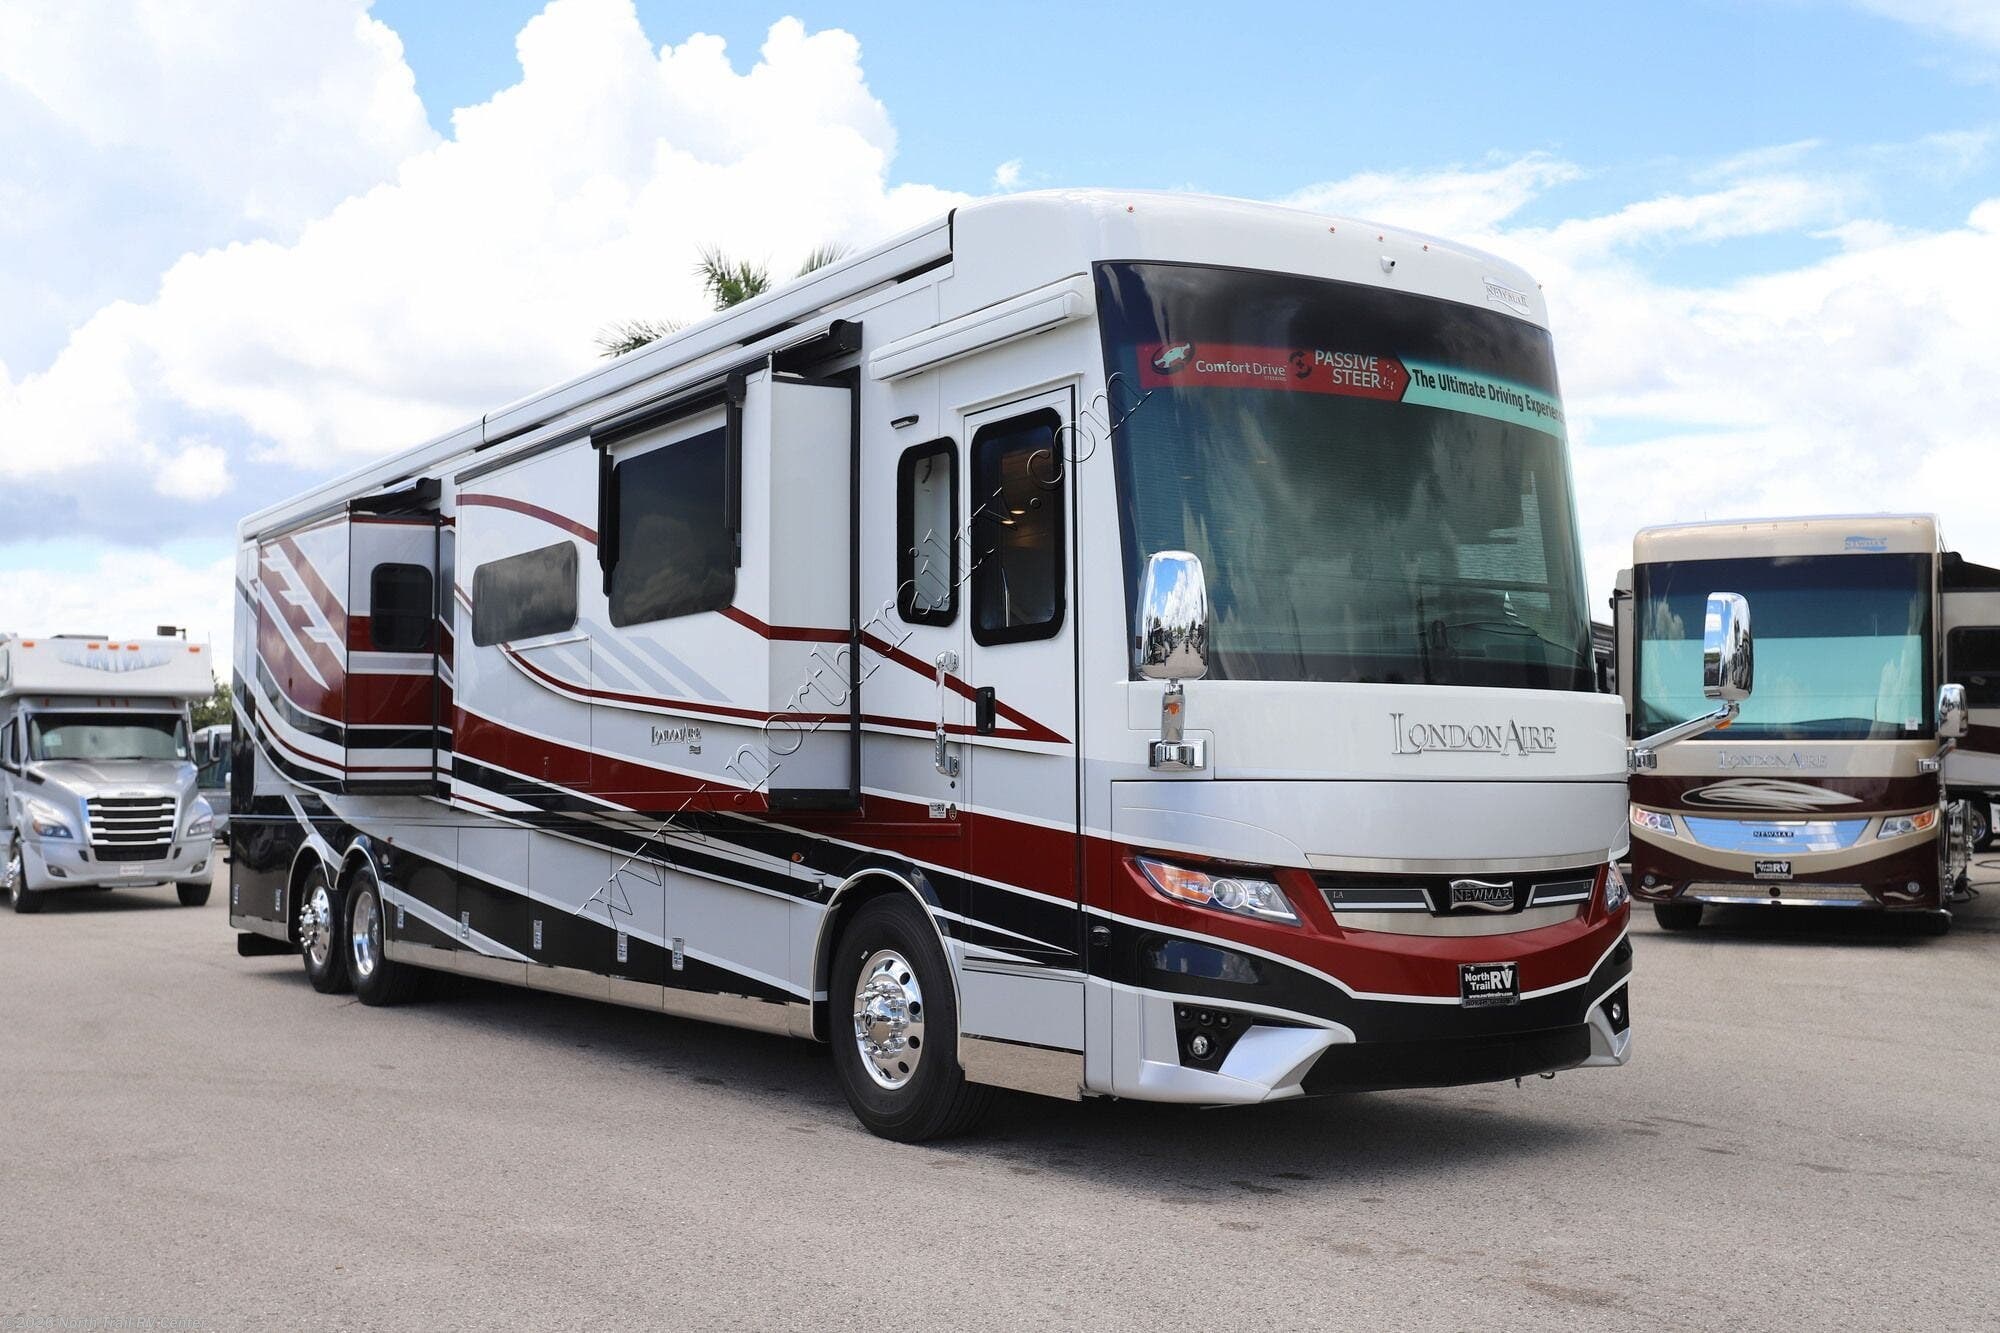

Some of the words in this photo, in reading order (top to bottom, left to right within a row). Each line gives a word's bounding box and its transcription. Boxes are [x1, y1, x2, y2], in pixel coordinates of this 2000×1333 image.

[1196, 360, 1251, 373] Comfort
[1253, 362, 1285, 376] Drive
[1315, 349, 1378, 372] PASSIVE
[1333, 368, 1381, 389] STEER
[1412, 368, 1436, 389] The
[1438, 373, 1486, 399] Ultimate
[1488, 383, 1524, 412] Driving
[1773, 863, 1789, 873] RV
[1454, 888, 1512, 901] NEWMAR
[1465, 972, 1490, 982] North
[1490, 969, 1513, 990] RV
[1470, 981, 1491, 991] Trail
